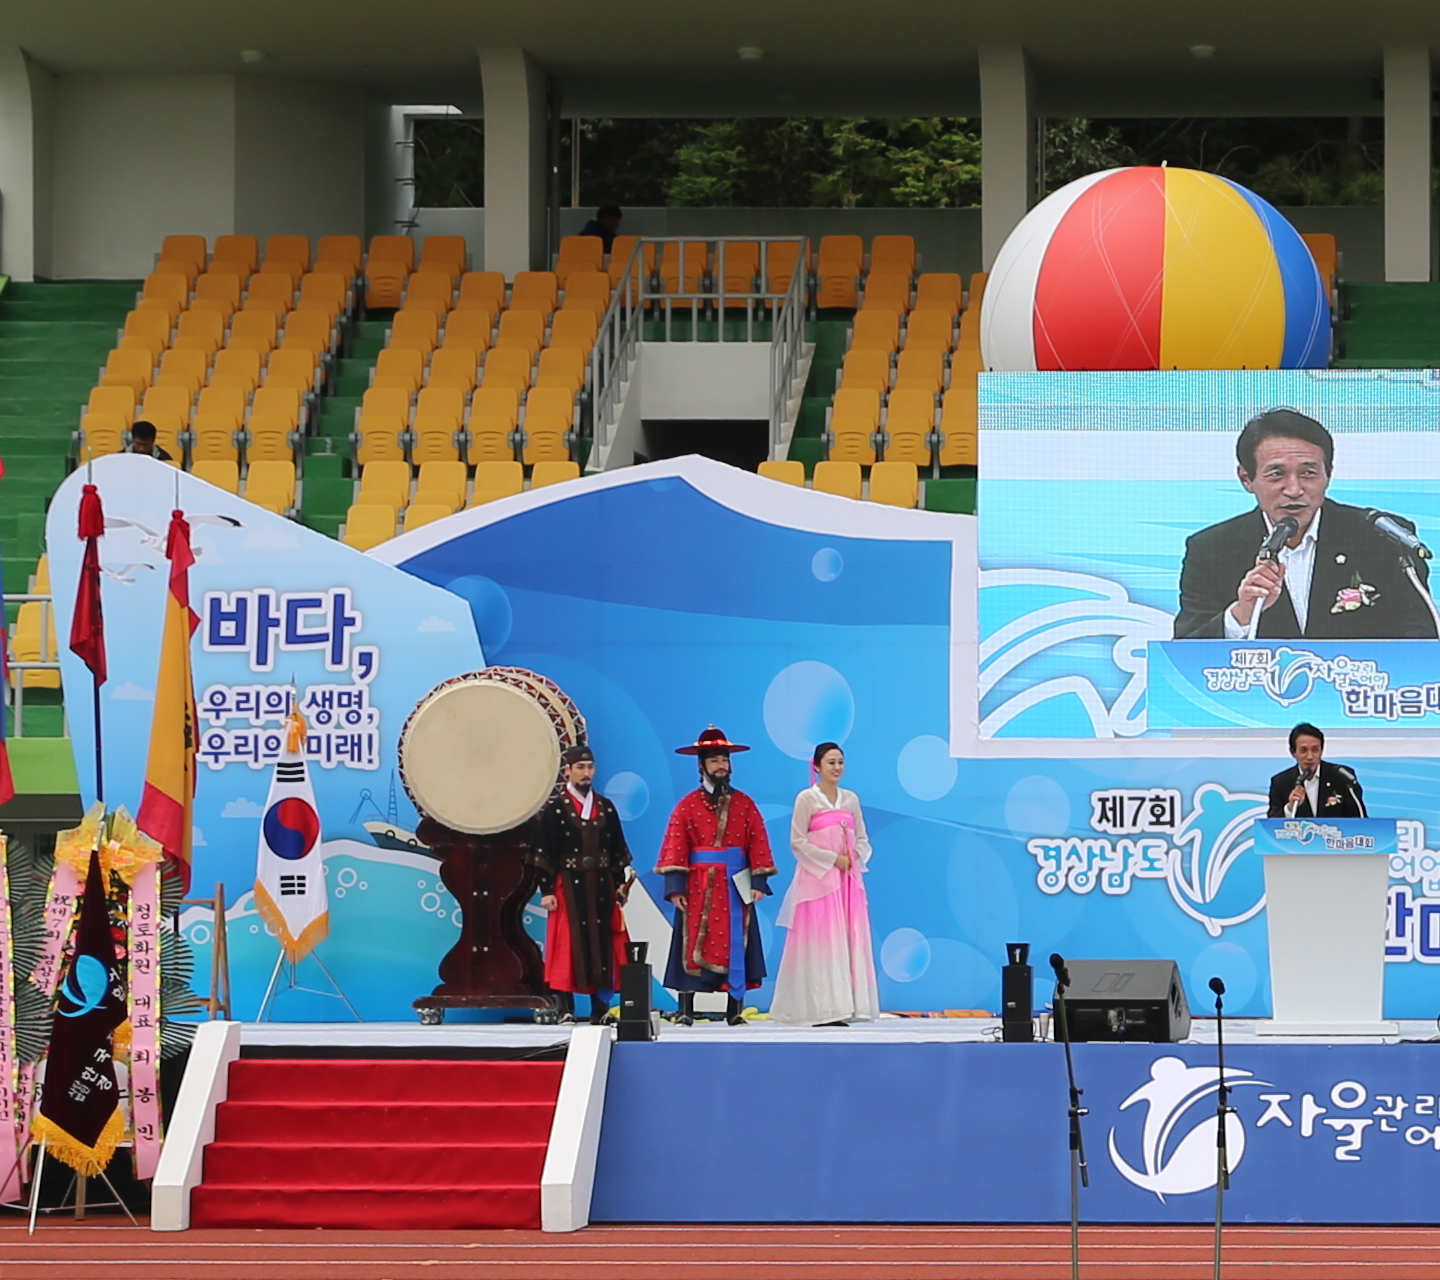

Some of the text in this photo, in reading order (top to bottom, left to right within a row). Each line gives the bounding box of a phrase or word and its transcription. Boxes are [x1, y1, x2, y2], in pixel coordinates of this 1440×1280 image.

[210, 593, 373, 680] 바다,
[1233, 650, 1271, 666] 제7회
[1206, 669, 1266, 689] 경상남도
[203, 690, 374, 725] 우리의 생명,
[305, 733, 374, 764] 미래!
[1097, 796, 1175, 828] 제7회
[1032, 844, 1166, 888] 경상남도
